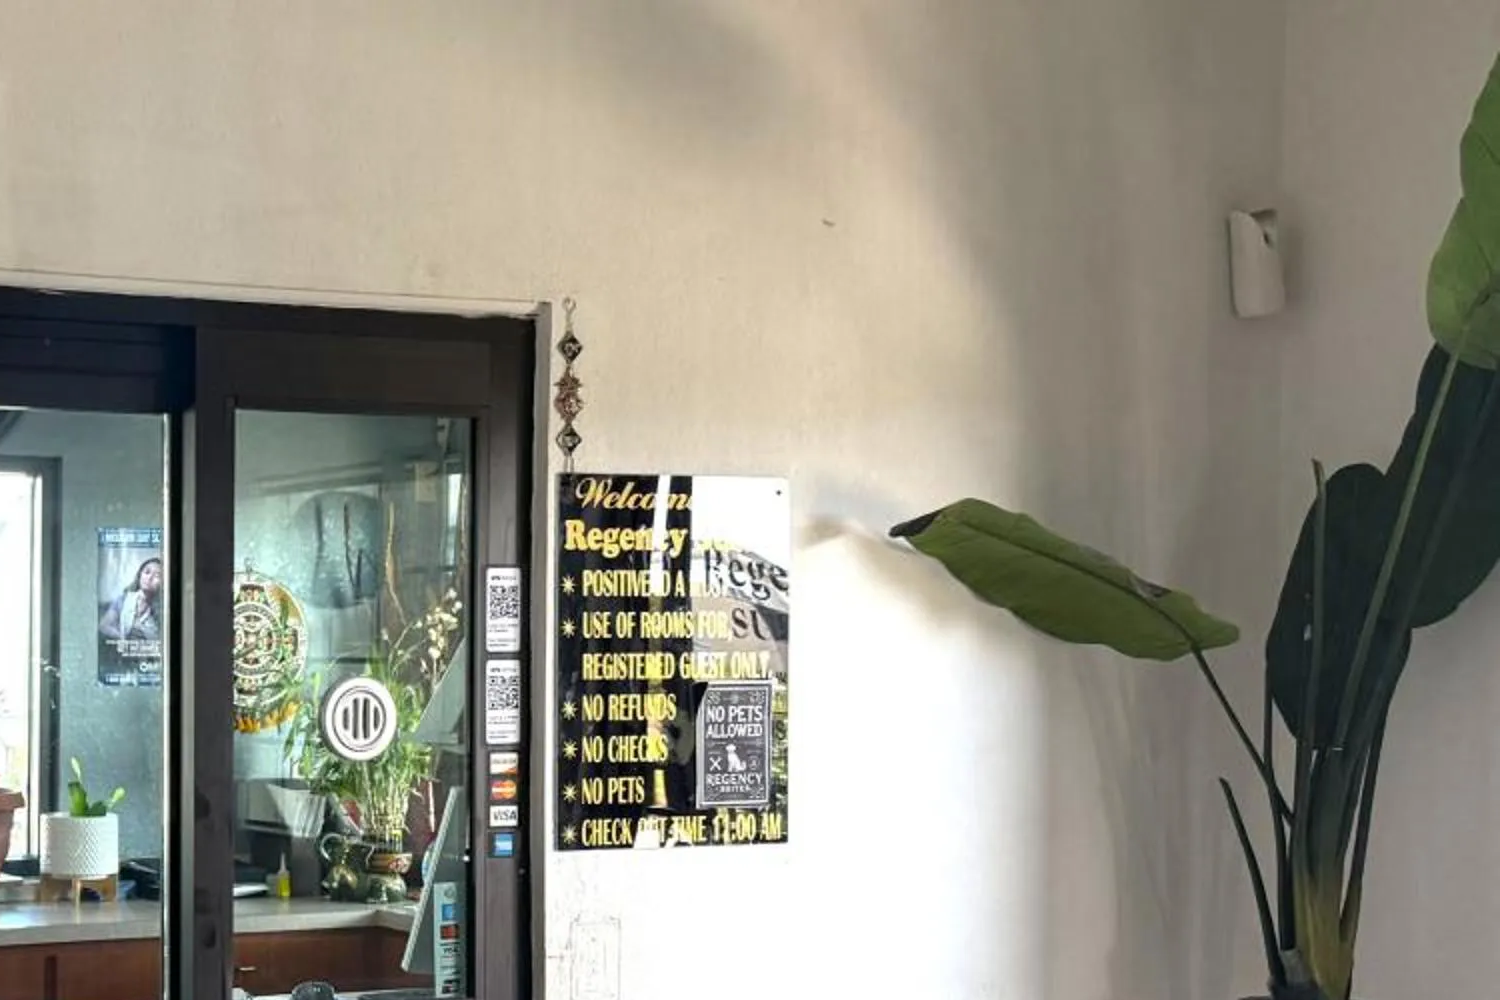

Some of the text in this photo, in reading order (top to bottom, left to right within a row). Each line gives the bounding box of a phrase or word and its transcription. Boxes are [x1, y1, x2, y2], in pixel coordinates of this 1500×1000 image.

[564, 520, 688, 558] Regeny
[582, 570, 651, 597] POSITIVE
[675, 570, 685, 596] A
[582, 612, 612, 638] USE
[616, 612, 636, 638] OF
[640, 611, 692, 638] ROOMS
[582, 653, 675, 680] REGISTERED
[679, 652, 727, 679] GUEST
[582, 694, 676, 720] NO REFUNDS
[706, 706, 762, 722] NO PETS
[706, 724, 762, 738] ALLOWED
[582, 736, 668, 762] NO CHECKS
[582, 777, 644, 805] NO PETS
[706, 773, 762, 786] REGENCY
[582, 818, 632, 845] CHECK
[759, 813, 781, 840] AM
